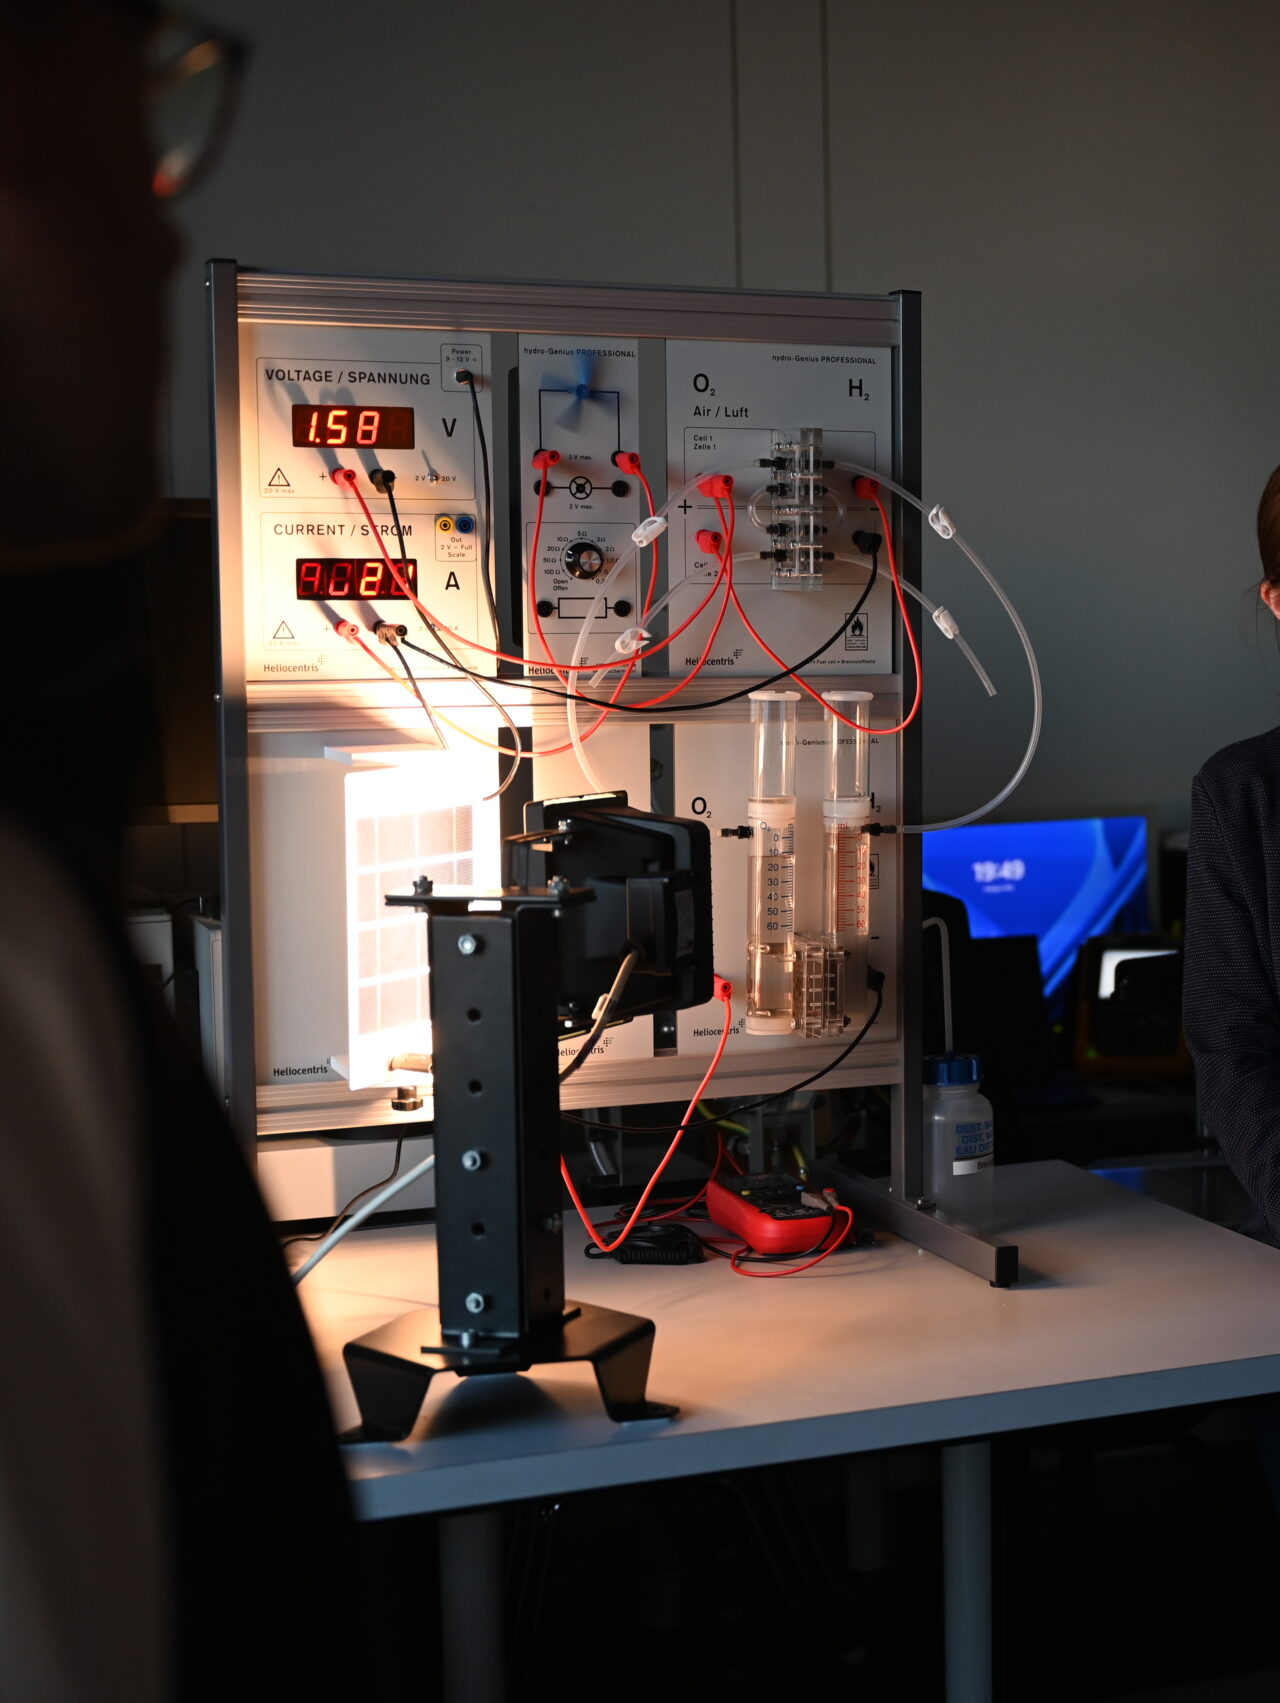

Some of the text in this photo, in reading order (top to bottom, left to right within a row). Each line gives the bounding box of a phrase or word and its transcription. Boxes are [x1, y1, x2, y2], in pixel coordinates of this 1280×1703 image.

[576, 349, 636, 358] PROFESSIONAL
[772, 354, 876, 364] hydro-Genius PROFESSIONAL
[265, 369, 333, 382] VOLTAGE
[347, 371, 430, 385] SPANNUNG
[693, 406, 711, 417] Air
[724, 406, 749, 418] Luft
[309, 410, 380, 445] 1.58
[442, 418, 457, 438] V
[274, 524, 345, 536] CURRENT
[445, 571, 460, 591] A
[263, 664, 319, 673] Heliocentris
[773, 834, 779, 842] 0
[769, 849, 779, 857] 10
[768, 863, 779, 871] 20
[857, 862, 865, 870] 20
[767, 878, 779, 886] 30
[767, 893, 779, 901] 40
[767, 908, 779, 916] 50
[857, 906, 865, 914] 50
[767, 922, 779, 930] 60
[856, 920, 866, 928] 60
[273, 1065, 328, 1077] Heliocentris
[955, 1145, 976, 1155] EAU
